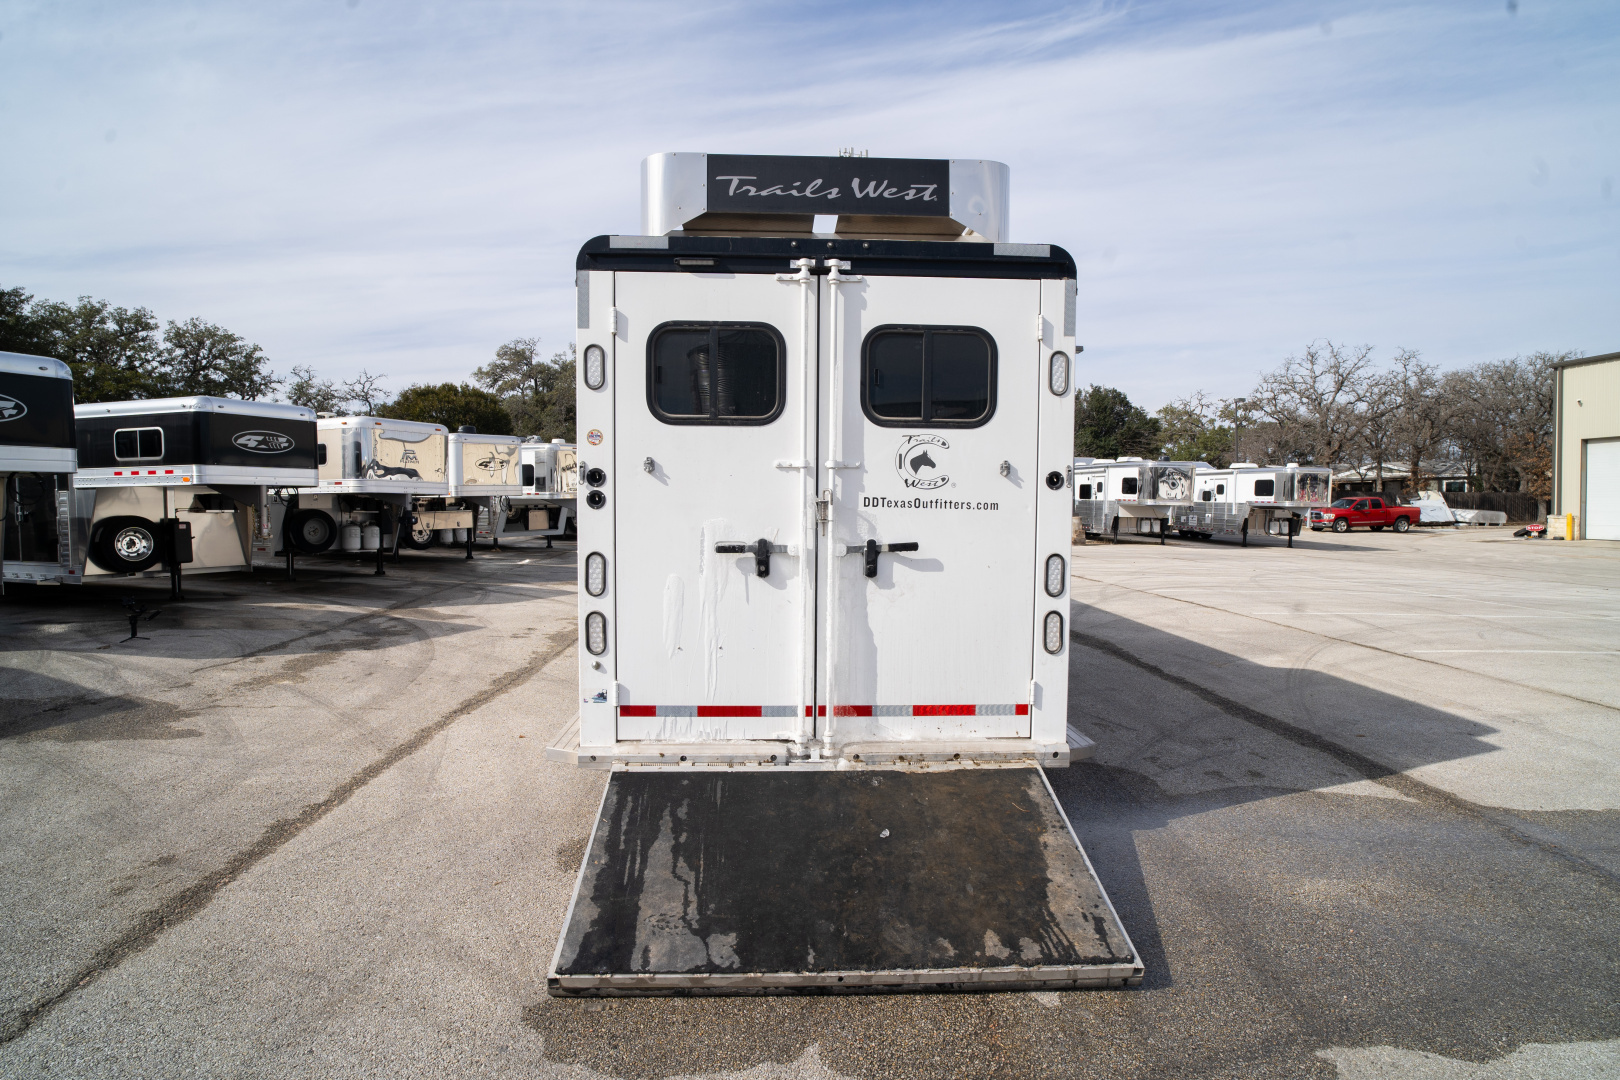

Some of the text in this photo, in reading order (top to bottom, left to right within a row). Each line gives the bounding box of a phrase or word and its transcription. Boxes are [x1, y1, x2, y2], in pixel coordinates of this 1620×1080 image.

[715, 175, 938, 201] Trails West
[902, 434, 941, 444] Trails
[904, 478, 939, 488] West
[863, 496, 999, 511] DDTexasOutfitters.com
